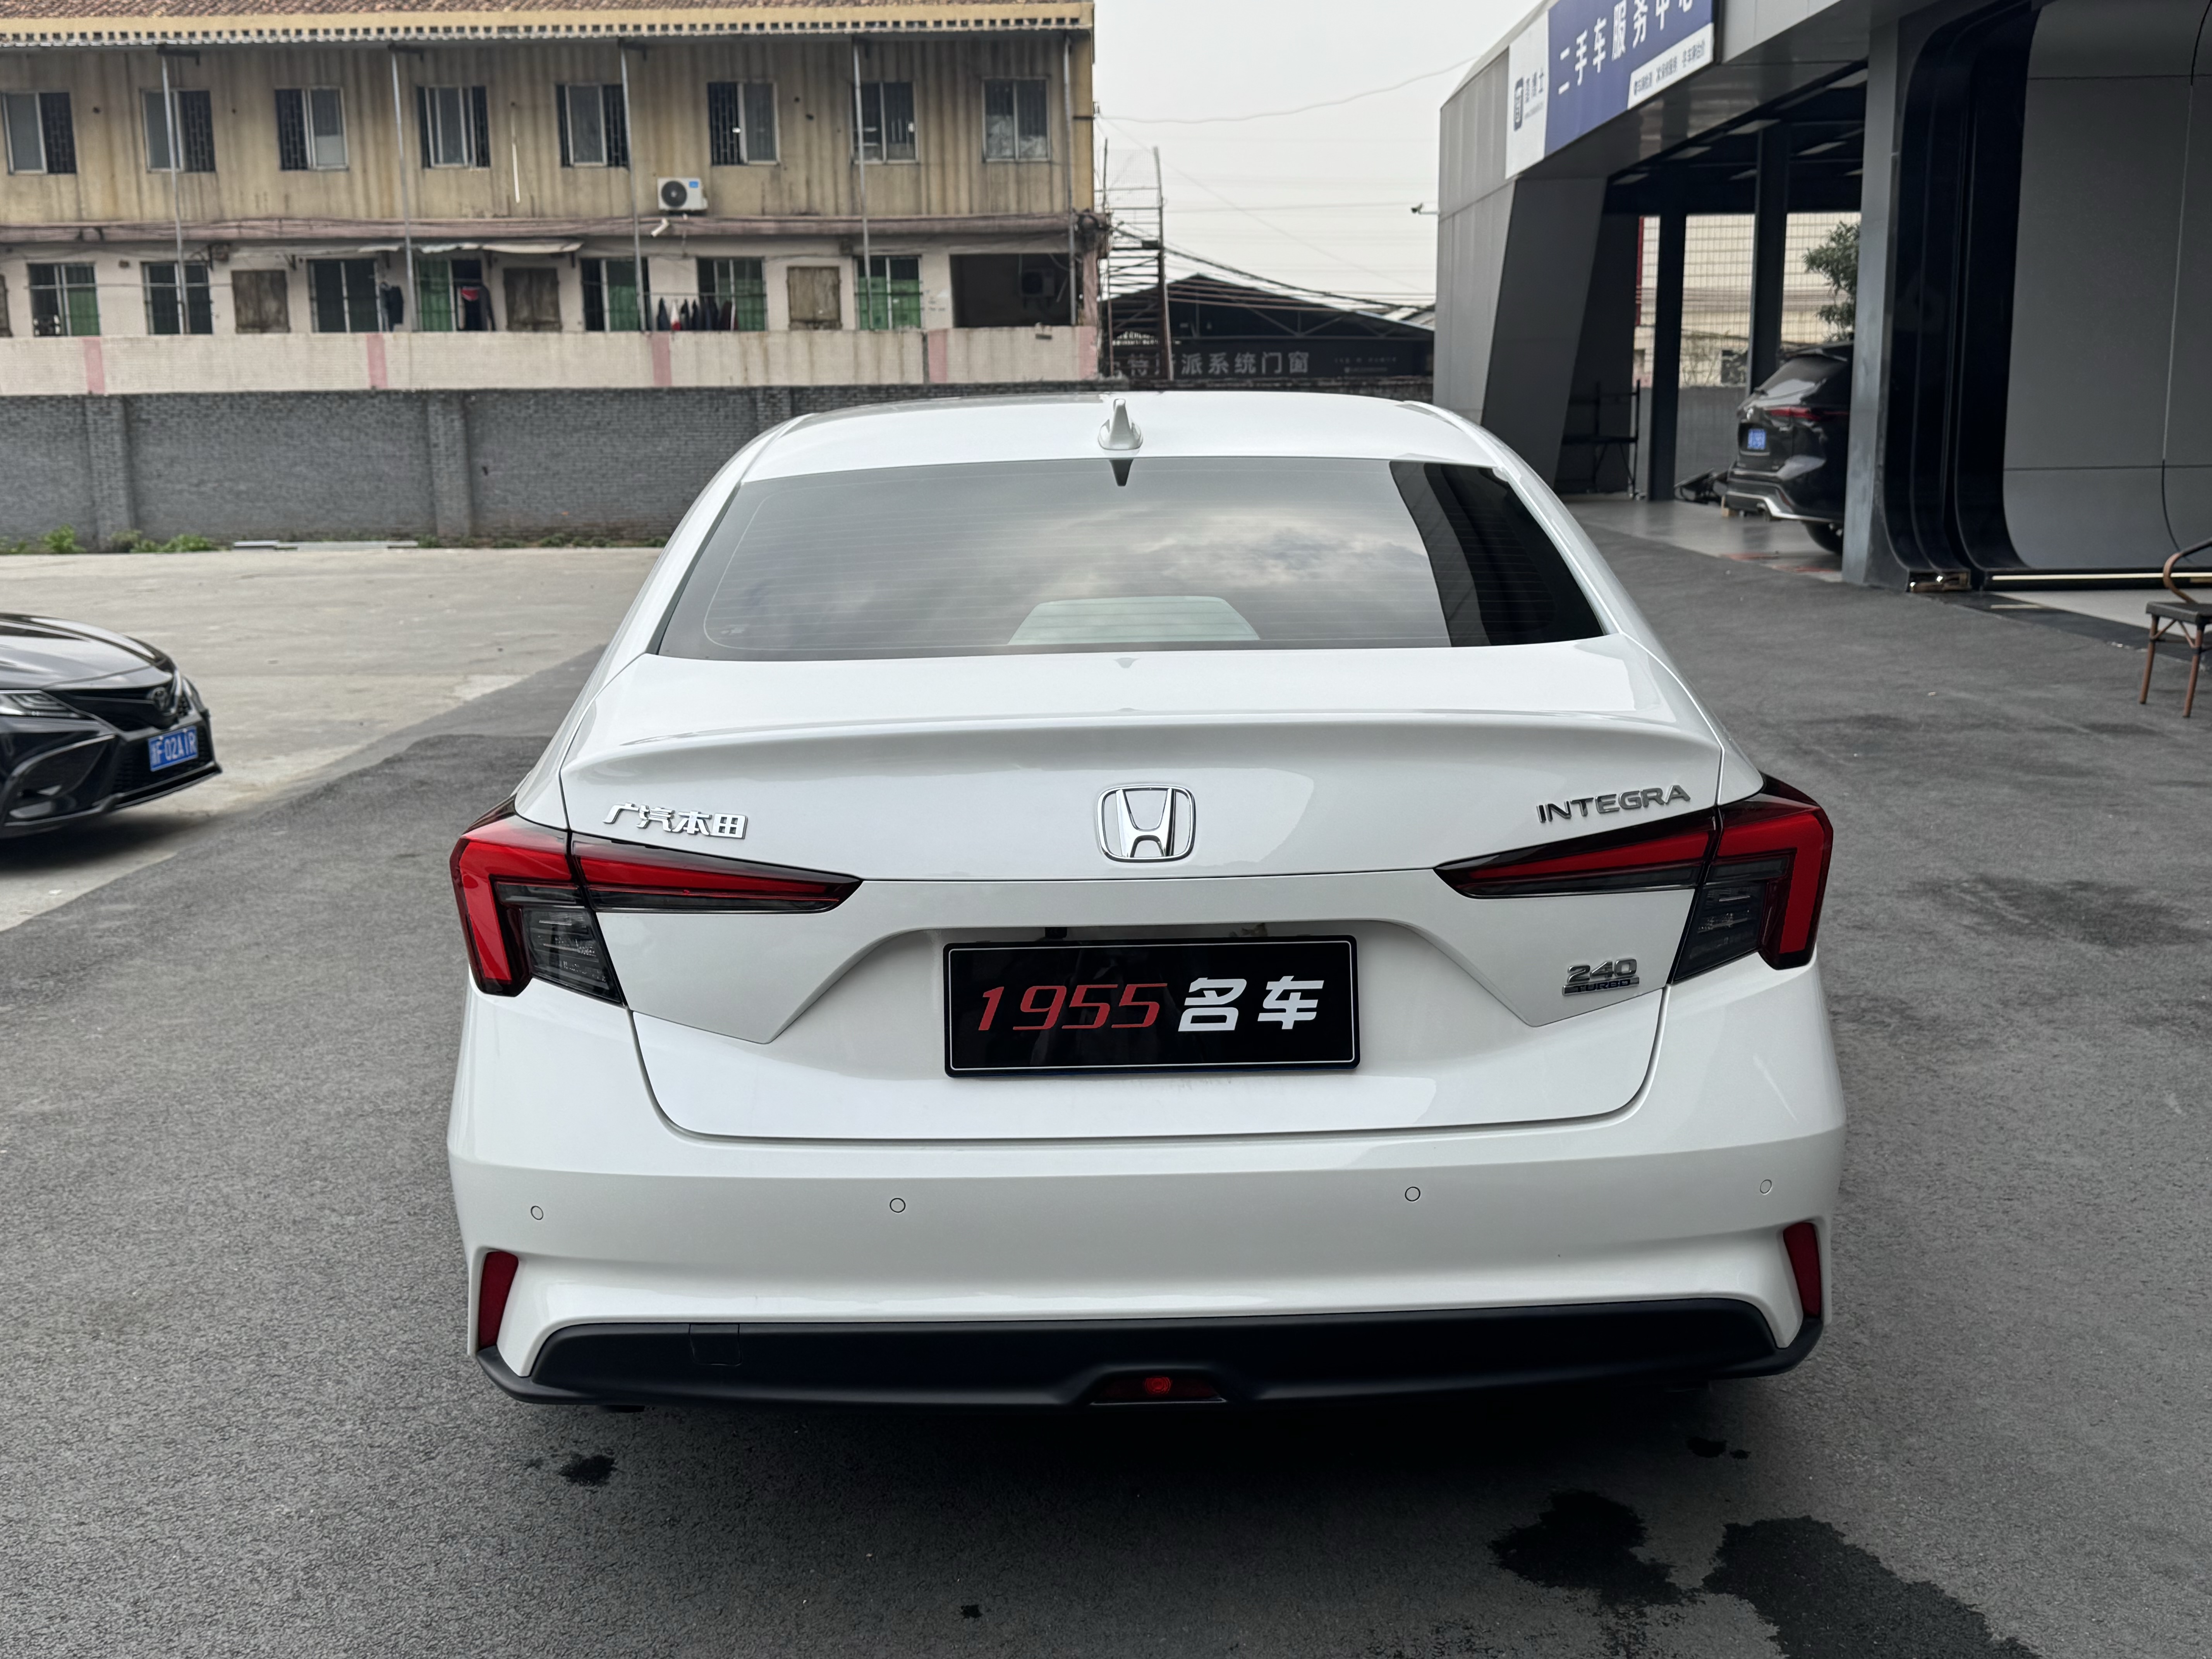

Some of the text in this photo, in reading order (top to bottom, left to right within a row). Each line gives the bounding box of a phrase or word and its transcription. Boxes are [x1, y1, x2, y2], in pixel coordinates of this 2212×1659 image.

[603, 802, 748, 840] 广汽本田
[1536, 785, 1690, 823] INTEGRA
[1567, 958, 1637, 984] 240
